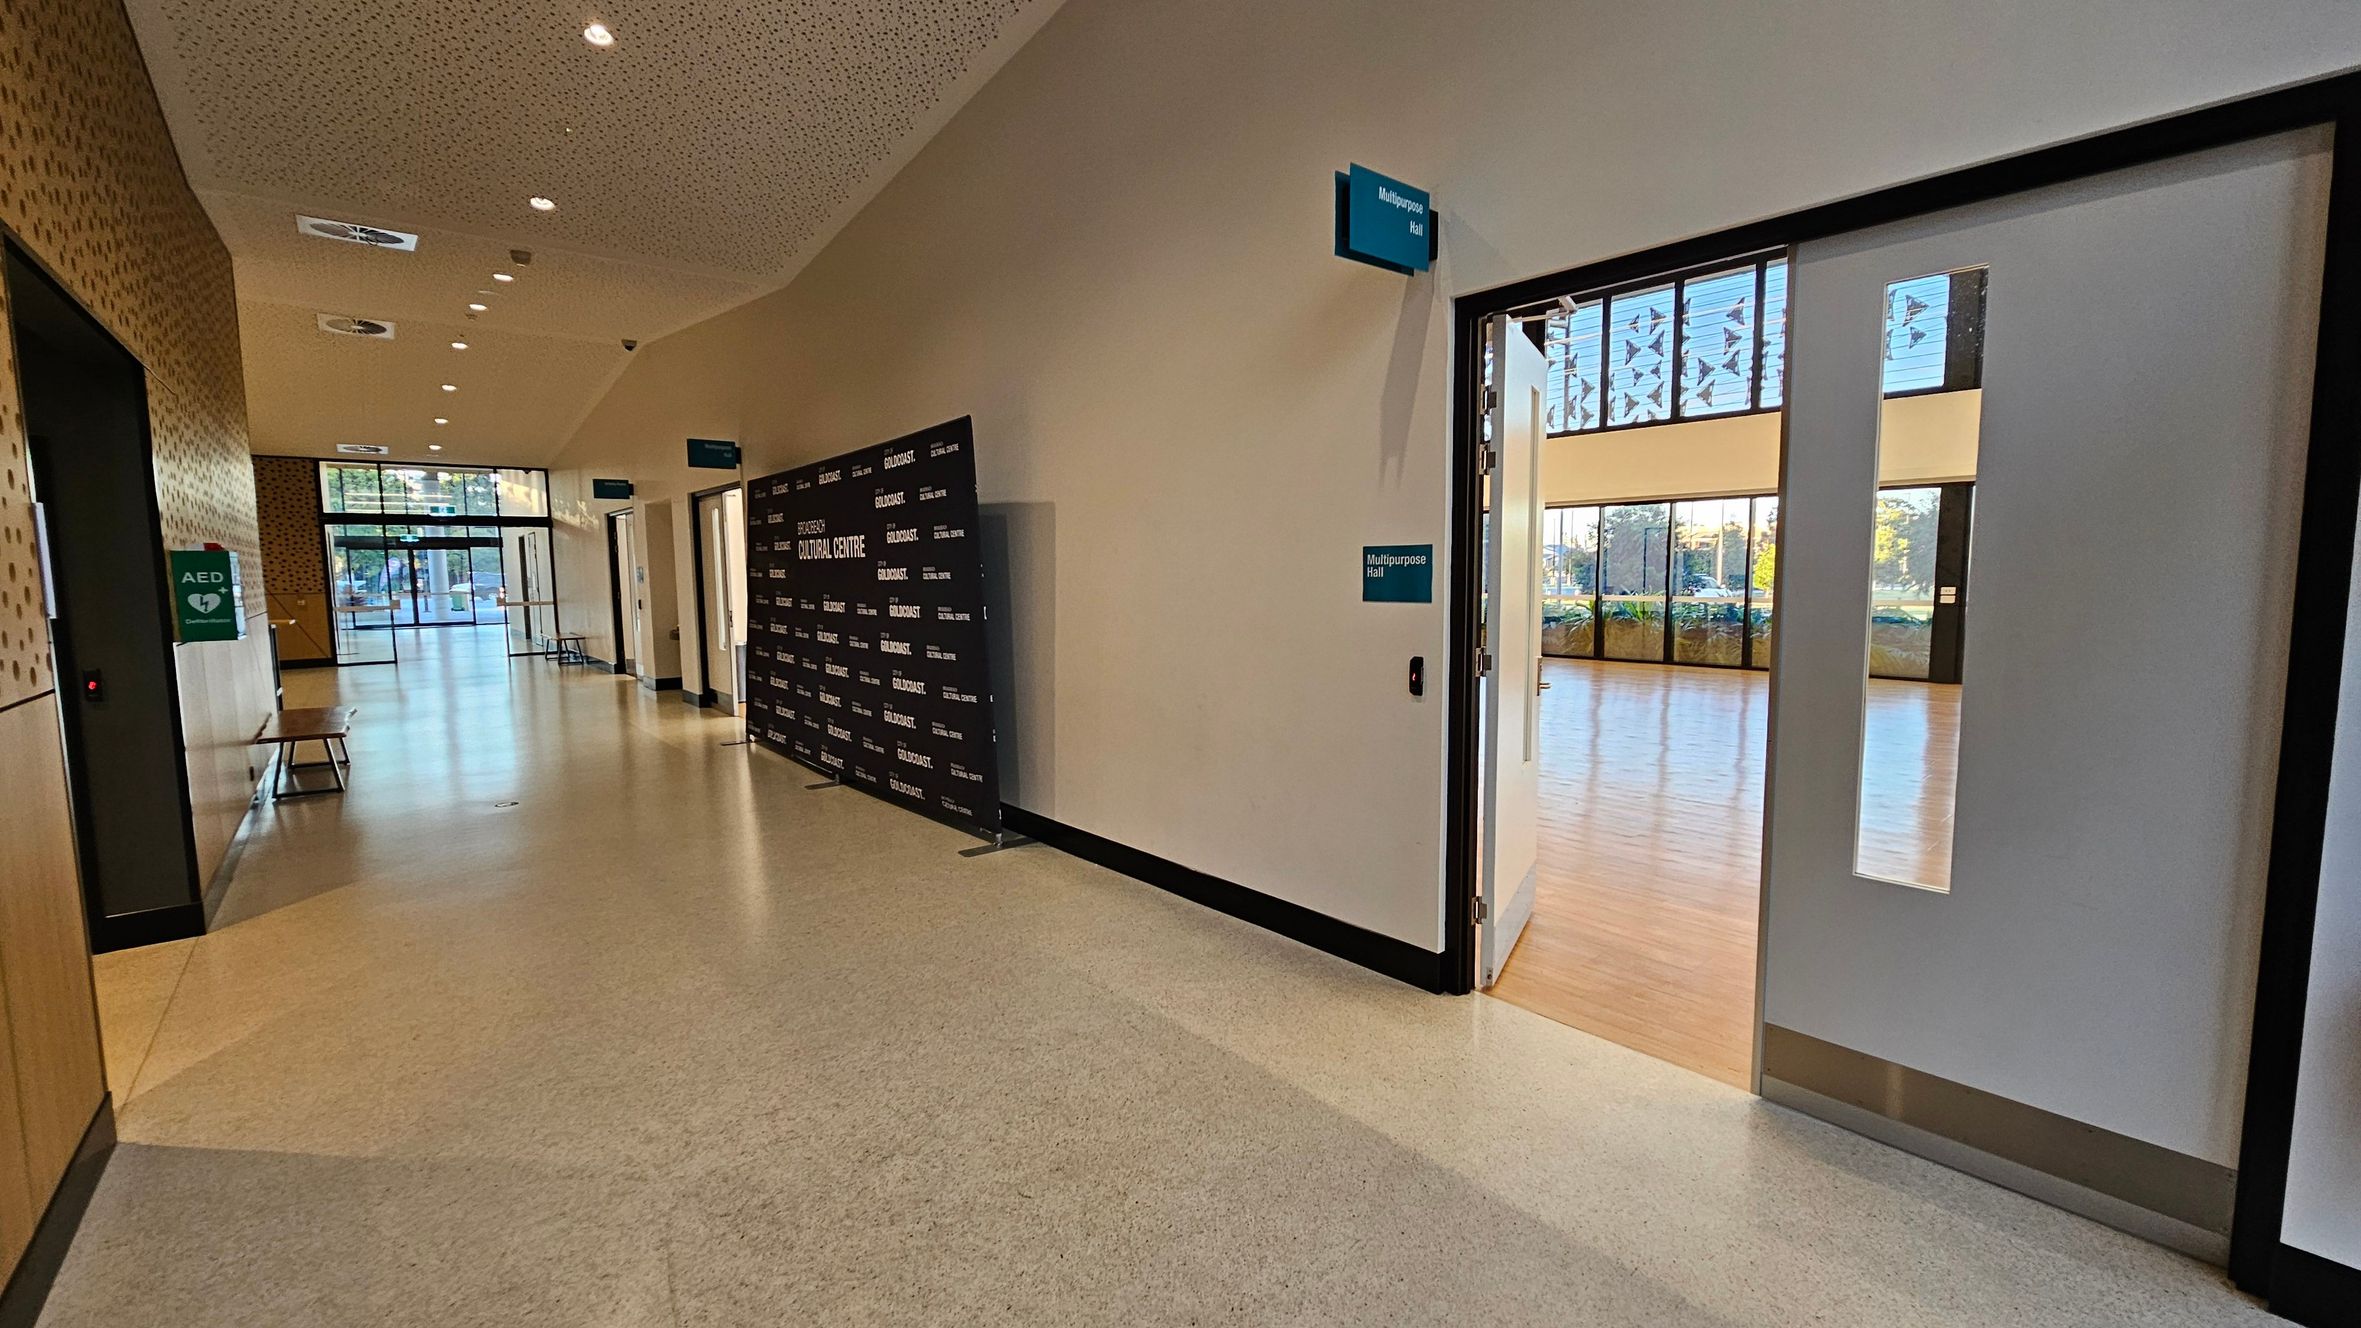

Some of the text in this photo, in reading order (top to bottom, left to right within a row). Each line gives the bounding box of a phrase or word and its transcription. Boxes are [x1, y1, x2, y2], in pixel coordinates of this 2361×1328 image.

[1379, 186, 1424, 214] Multipurpose
[1410, 220, 1423, 236] Hall
[798, 534, 866, 560] CULTURAL CENTRE
[1367, 554, 1426, 568] Multipurpose
[181, 572, 224, 584] AED
[1367, 566, 1384, 578] Hall
